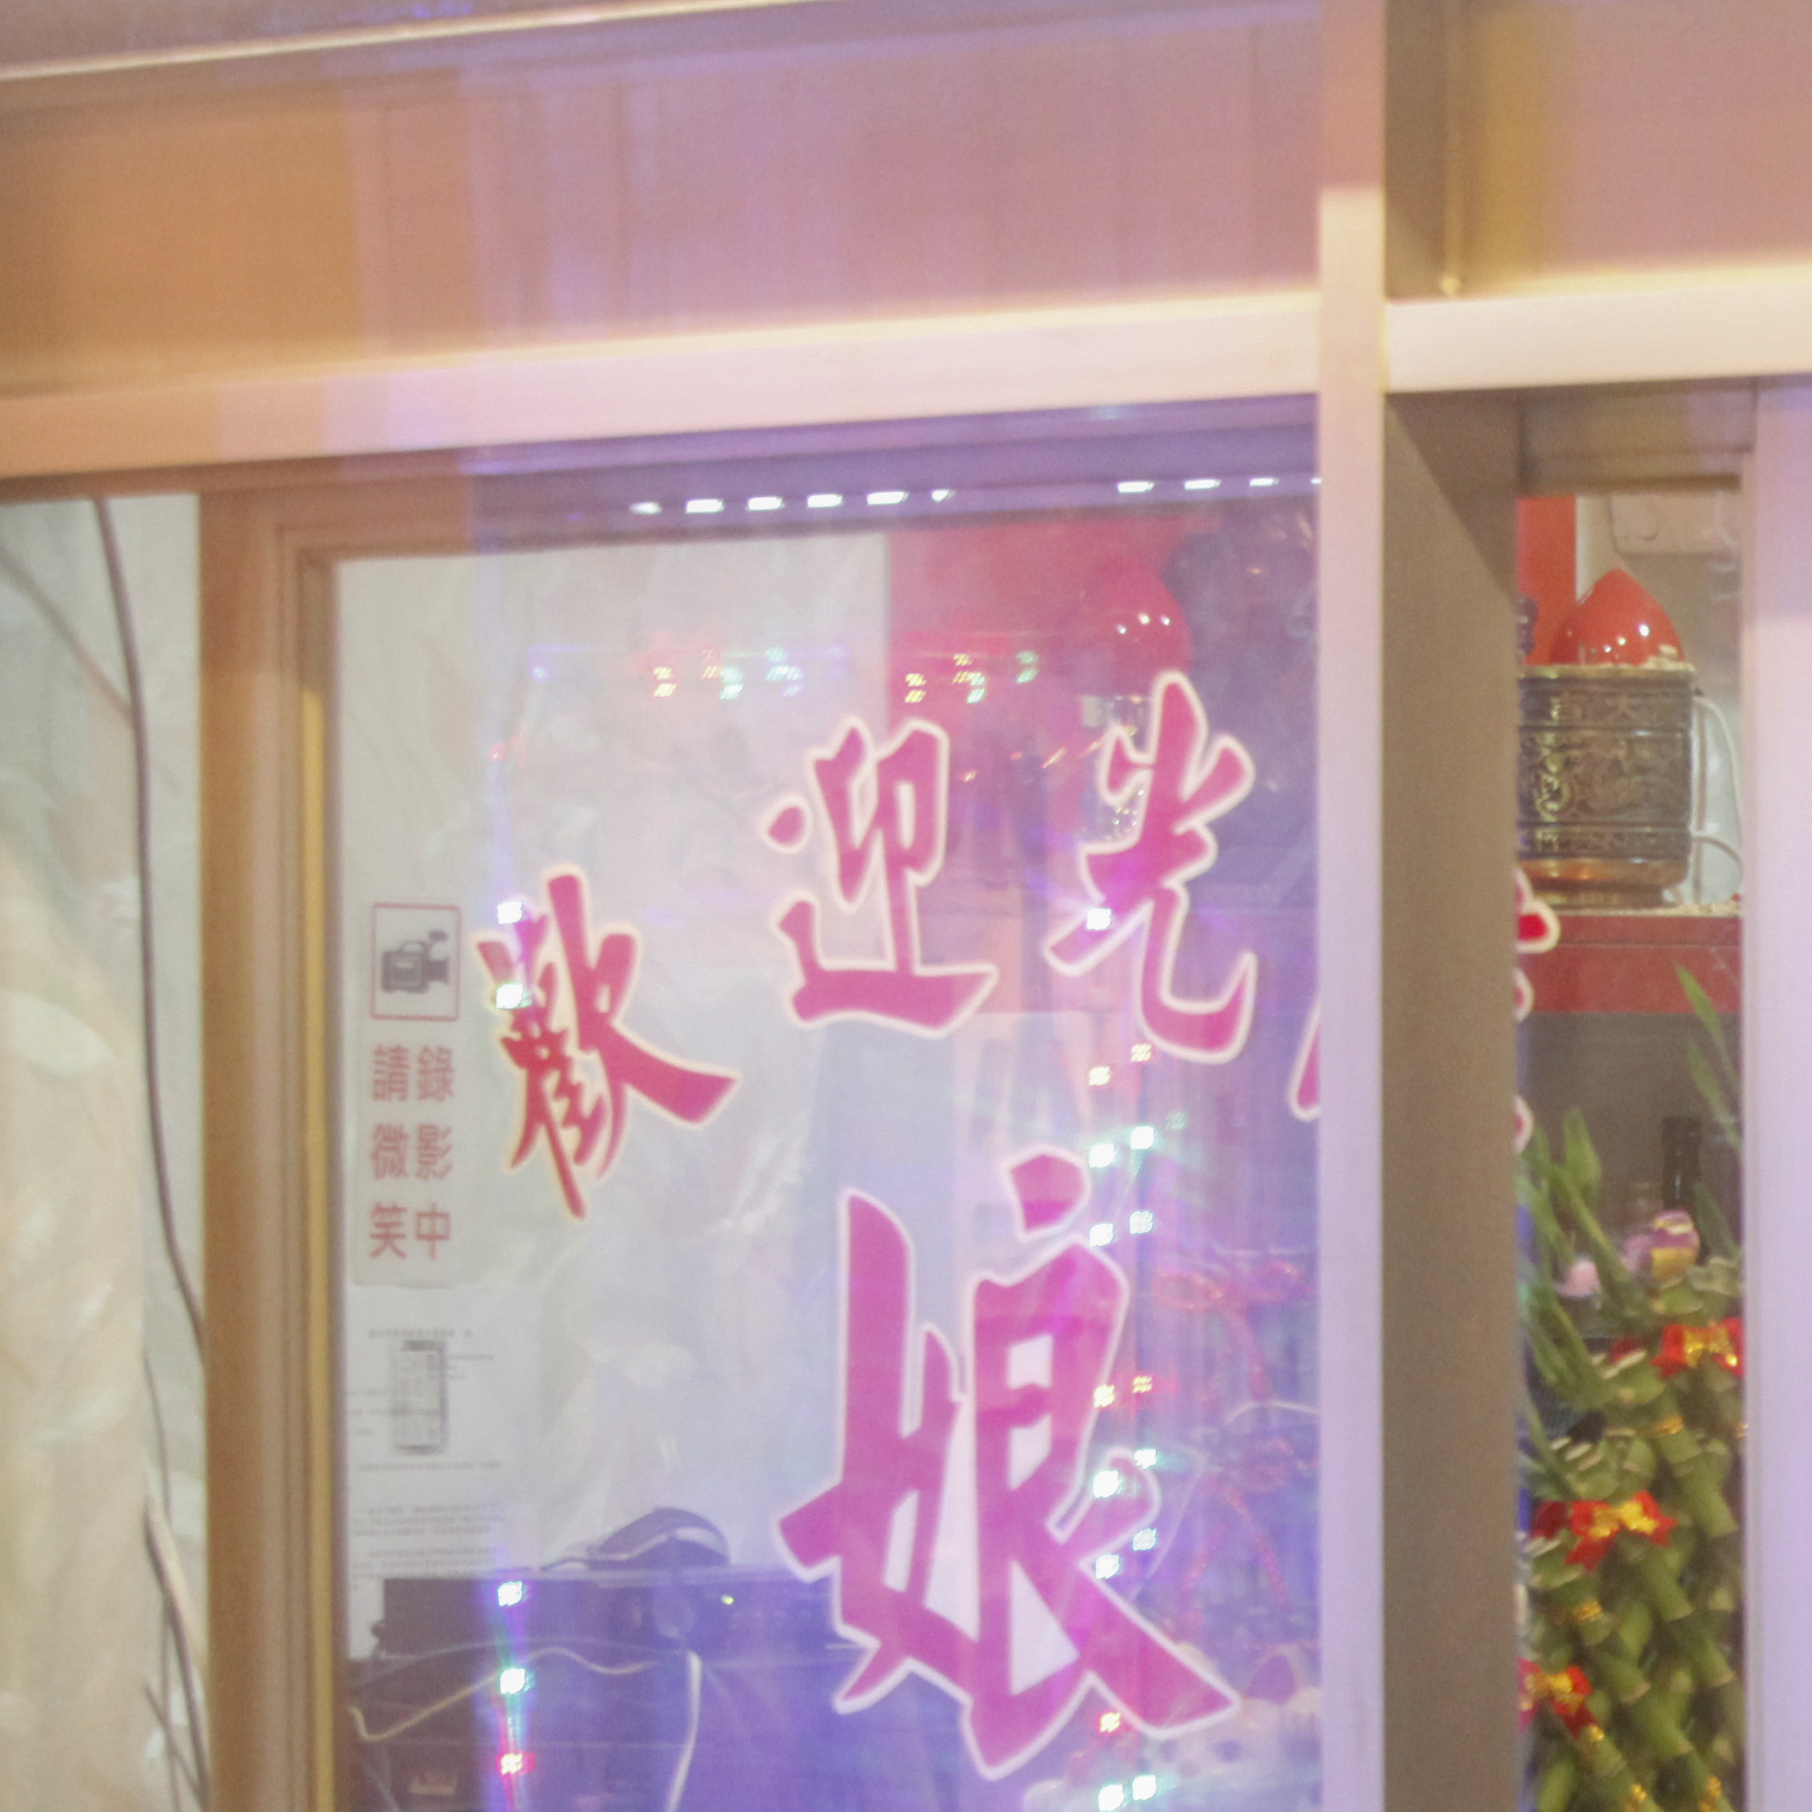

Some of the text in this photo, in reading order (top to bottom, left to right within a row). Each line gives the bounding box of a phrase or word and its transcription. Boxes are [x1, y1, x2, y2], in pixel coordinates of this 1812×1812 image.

[368, 1043, 411, 1262] 請微笑
[413, 1043, 455, 1262] 錄影中
